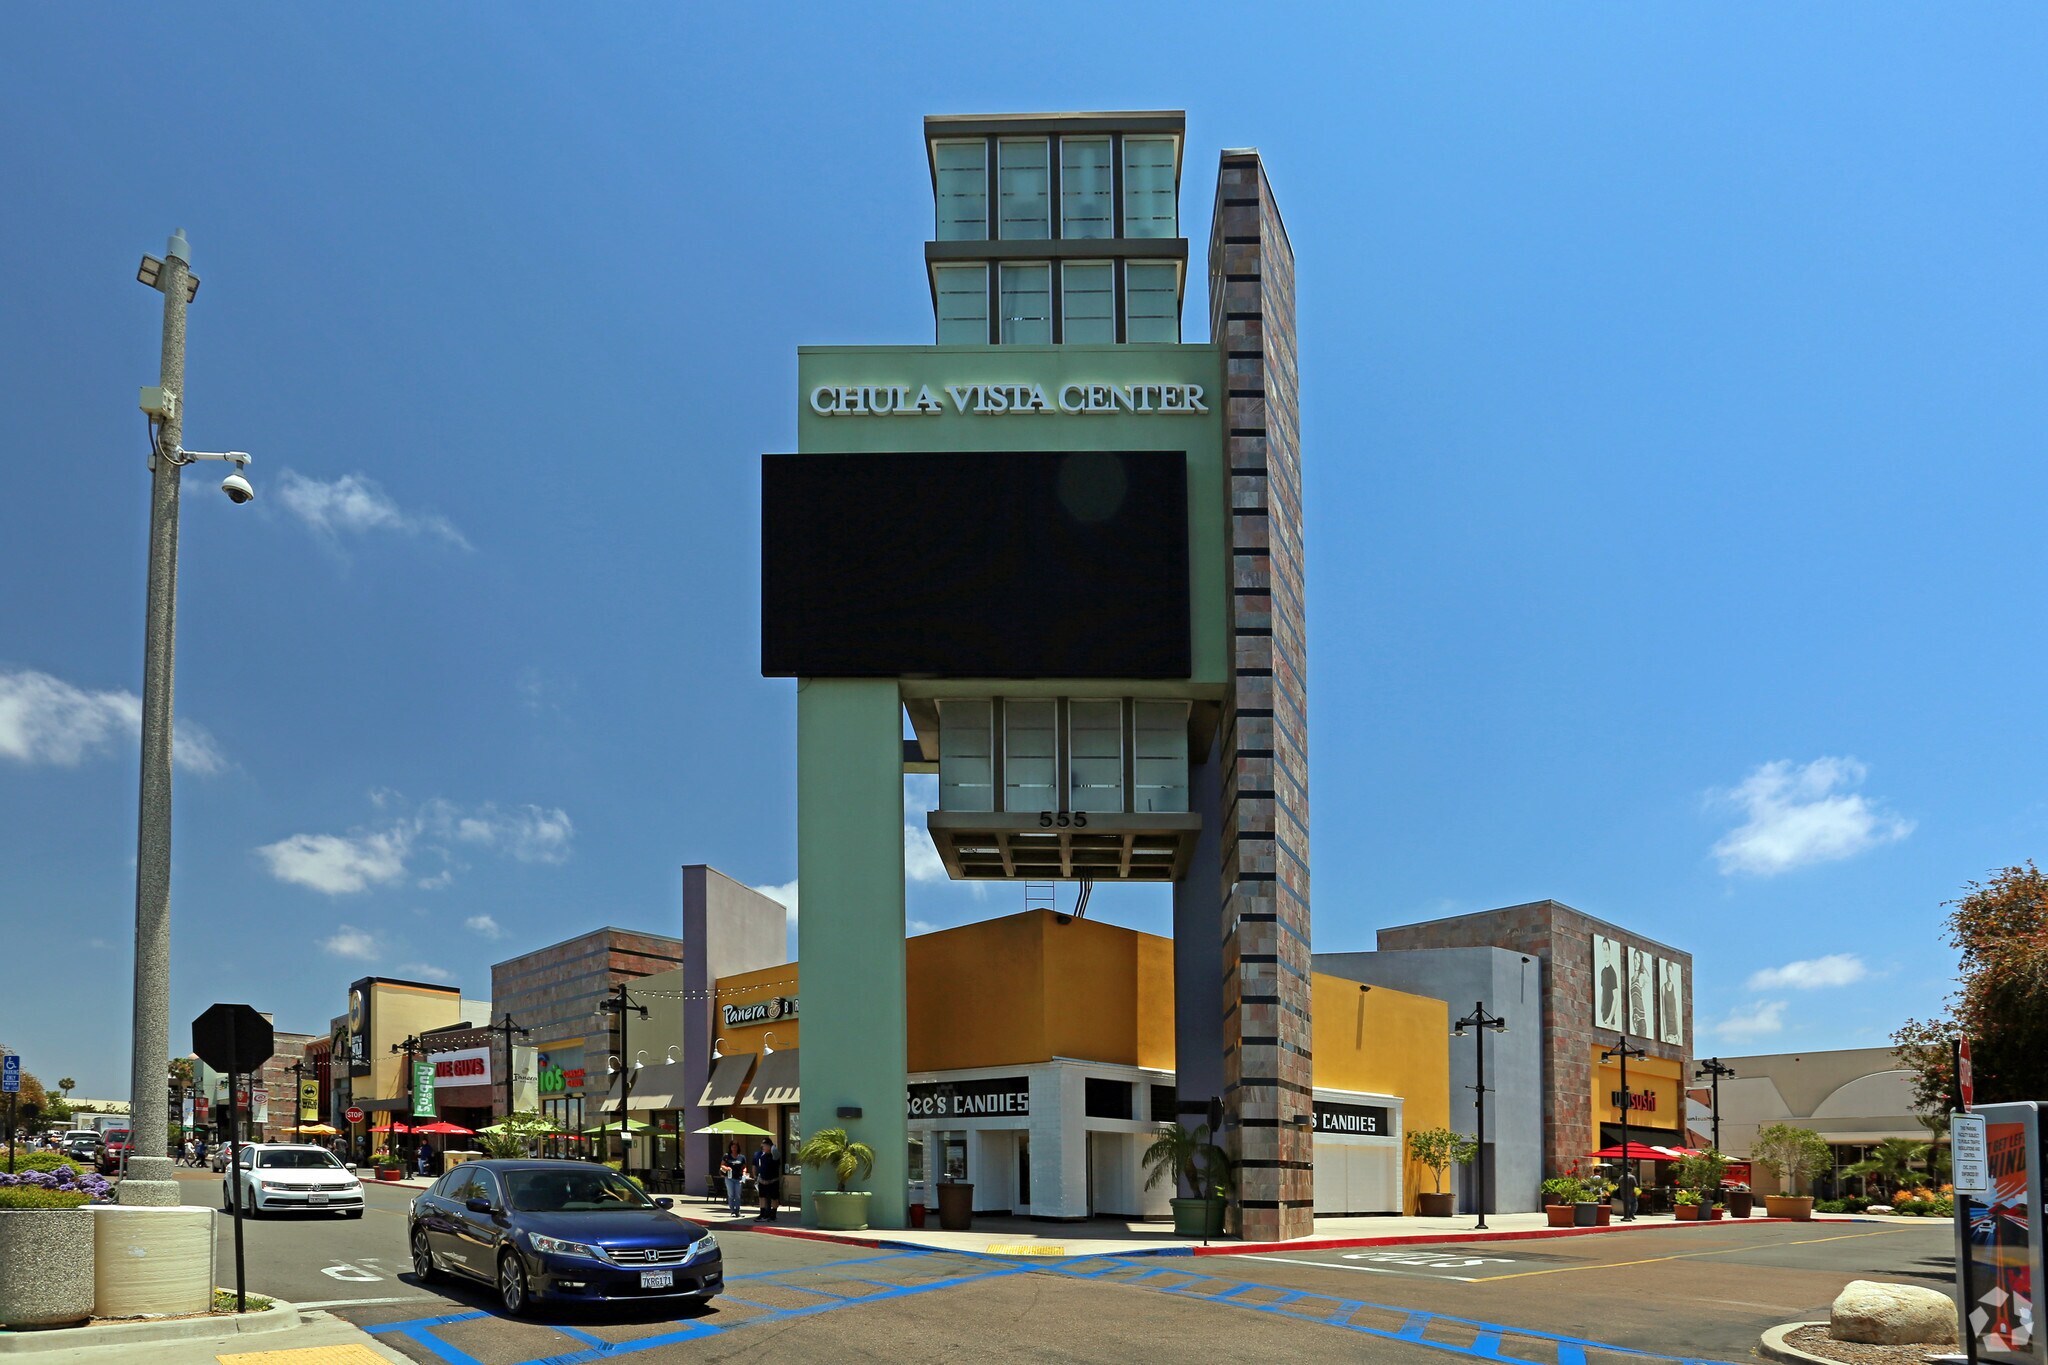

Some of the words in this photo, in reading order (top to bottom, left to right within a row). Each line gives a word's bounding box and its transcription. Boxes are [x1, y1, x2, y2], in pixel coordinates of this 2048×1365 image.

[810, 384, 942, 416] CHULA
[945, 383, 1056, 416] VISTA
[1058, 383, 1210, 416] CENTER
[1040, 811, 1087, 828] 555
[722, 1004, 766, 1024] Panera
[454, 1058, 485, 1076] GUYS
[417, 1066, 434, 1112] Rubio's
[953, 1093, 1029, 1113] CANDIES
[1322, 1113, 1376, 1132] CANDIES
[1988, 1147, 2026, 1179] HIND
